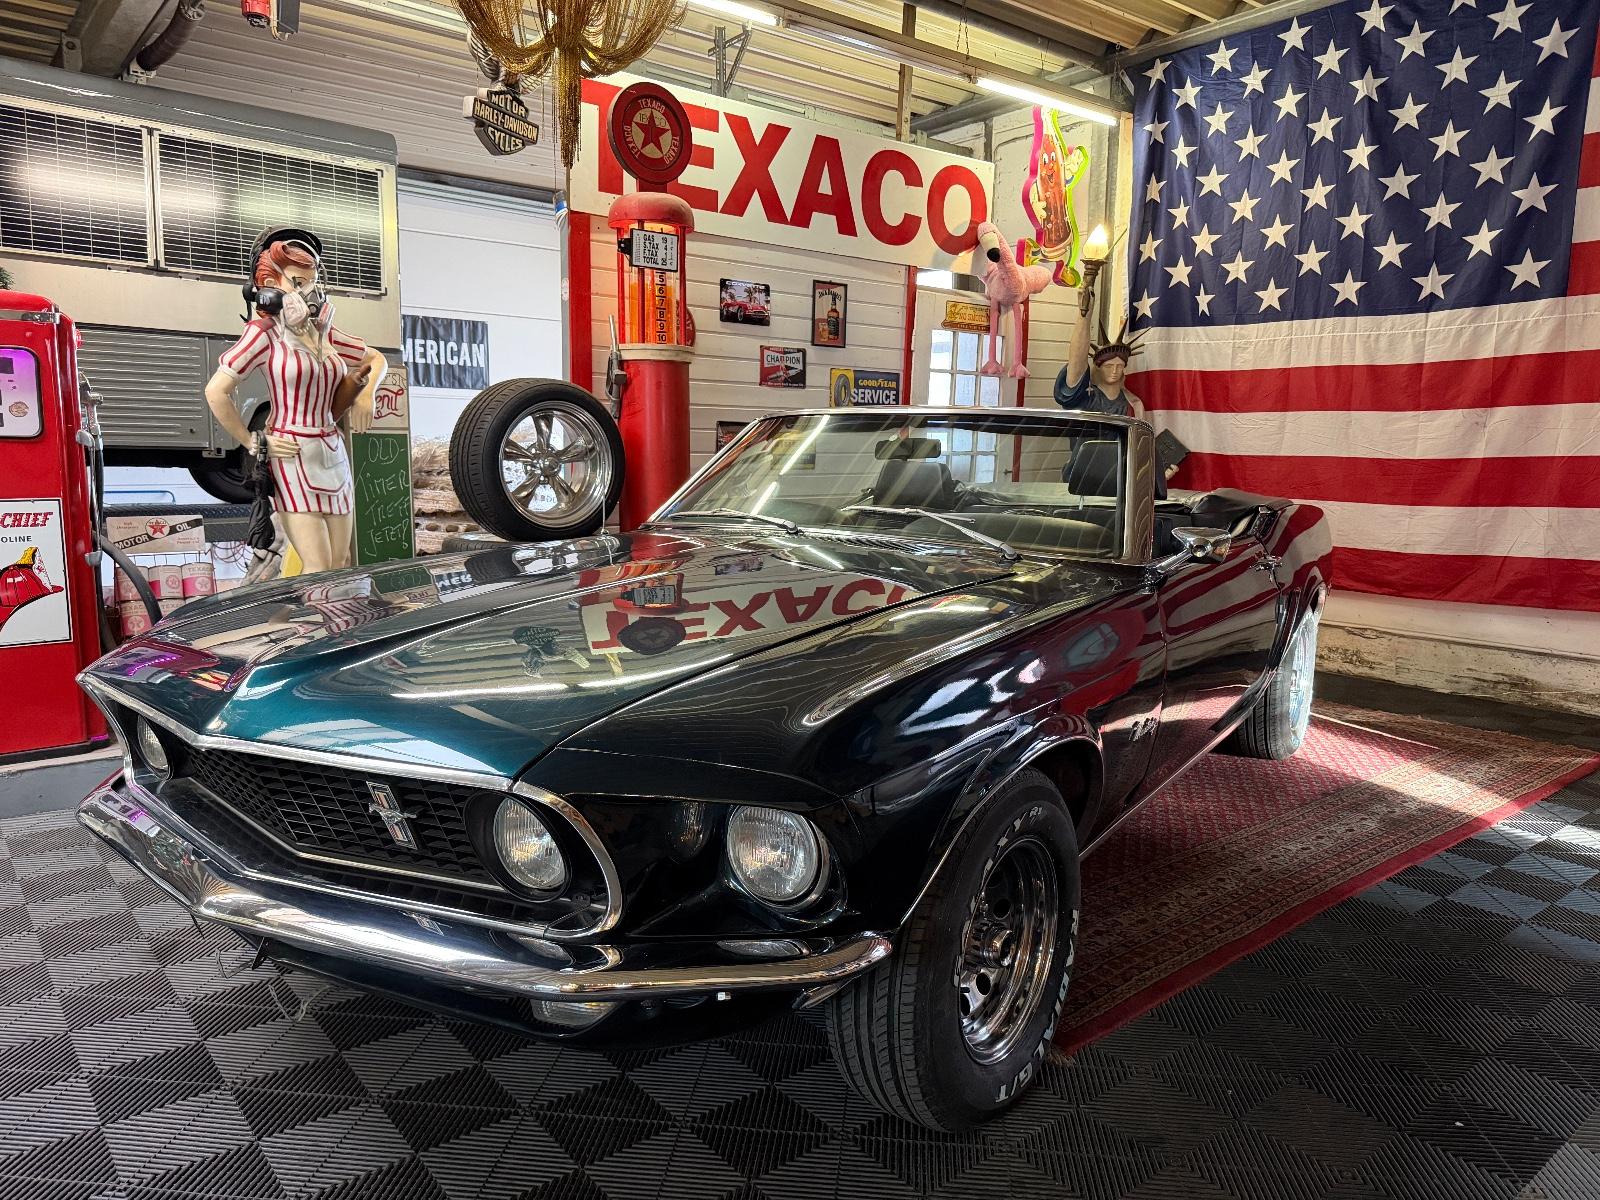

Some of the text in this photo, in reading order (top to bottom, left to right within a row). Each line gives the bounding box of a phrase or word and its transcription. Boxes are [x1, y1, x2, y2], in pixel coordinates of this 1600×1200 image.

[491, 93, 526, 117] MOTOR
[638, 98, 666, 114] TEXACO
[474, 99, 538, 141] HARLEY-DAVIDSON
[487, 126, 523, 152] CYCLES
[623, 125, 641, 159] TEXACO
[663, 136, 680, 165] TEXACO
[581, 79, 987, 256] TEXACO
[643, 234, 655, 243] GAS
[643, 241, 660, 251] S.TAX
[643, 249, 659, 258] F.TAX
[643, 256, 660, 266] TOTAL
[658, 274, 665, 283] 5
[658, 286, 665, 295] 6
[658, 298, 665, 307] 7
[658, 310, 665, 319] 8
[658, 322, 665, 331] 9
[656, 333, 667, 343] 10
[766, 353, 801, 365] CHAMPION
[850, 388, 897, 405] SERVICE
[0, 511, 54, 529] CHIEF
[1, 535, 33, 544] OLINE
[114, 522, 192, 550] MOTOR OIL
[994, 908, 1080, 1104] RADIAL G/T
